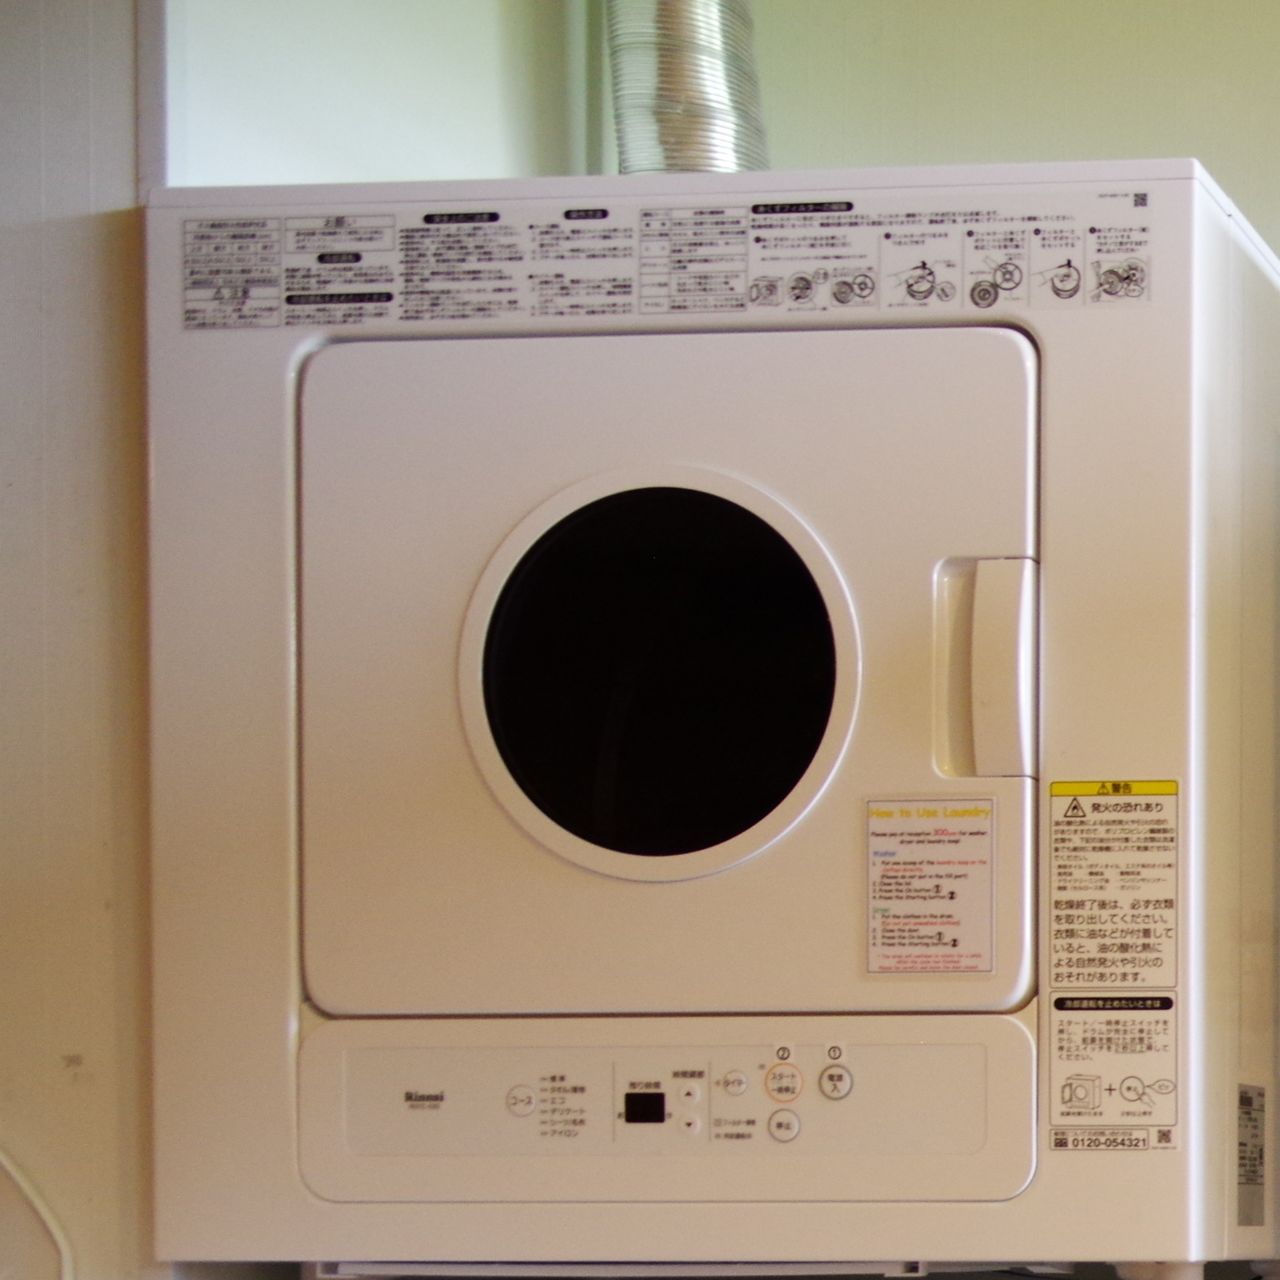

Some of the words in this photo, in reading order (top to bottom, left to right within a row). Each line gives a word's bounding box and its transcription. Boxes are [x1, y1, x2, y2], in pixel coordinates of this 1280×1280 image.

[1112, 784, 1132, 793] 警告
[1092, 802, 1163, 812] 発火の恐れあり
[870, 808, 892, 818] How
[900, 808, 912, 818] to
[919, 808, 938, 818] Use
[944, 807, 991, 818] Laundry
[1054, 899, 1174, 910] 乾燥終了後は、必ず衣類
[1054, 914, 1168, 924] を取り出してください。
[1054, 928, 1174, 938] 衣類に油などが付着して
[1054, 943, 1162, 953] いると、油の酸化熱に
[1054, 957, 1162, 968] よる自然発火や引火の
[1054, 972, 1145, 982] おそれがあります。
[828, 1075, 843, 1083] 電源
[405, 1092, 444, 1102] Rinnai
[511, 1096, 532, 1105] コース
[776, 1122, 790, 1130] 停止
[1072, 1138, 1146, 1147] 0120-054321
